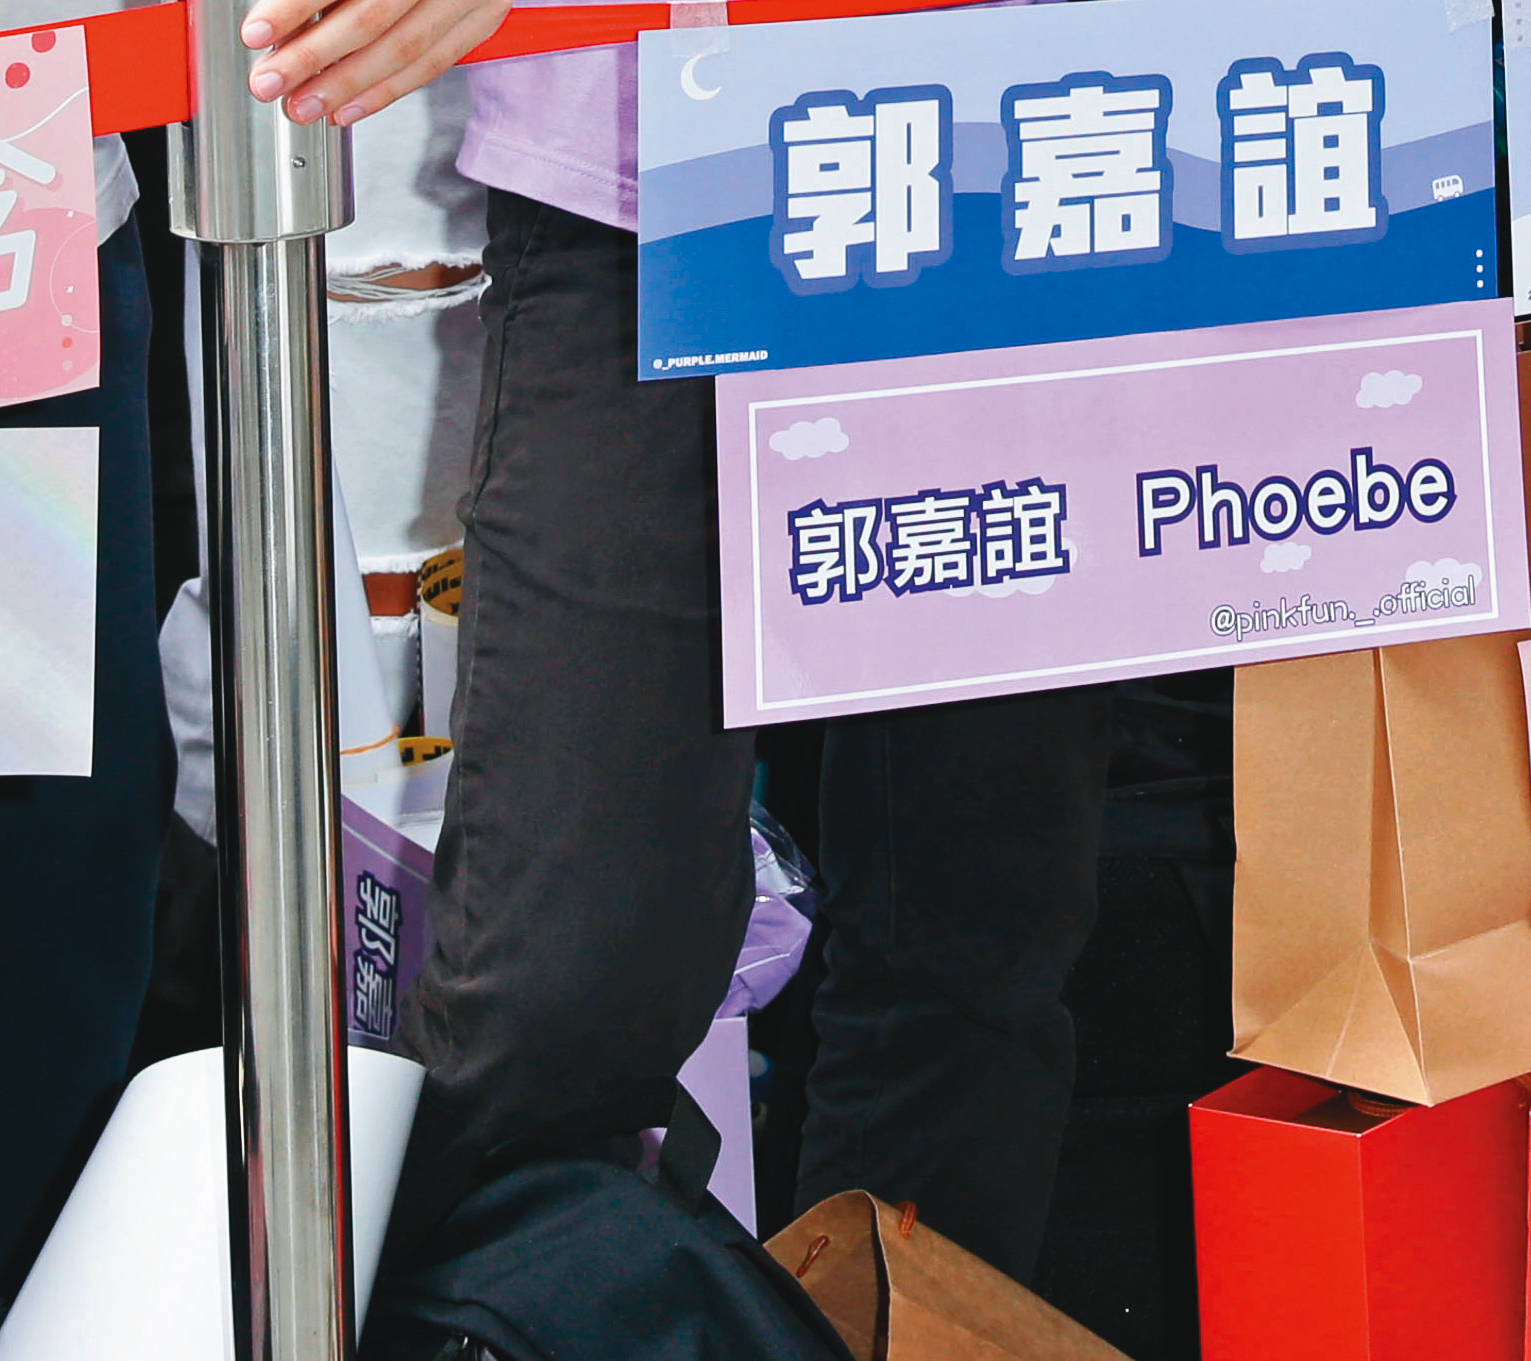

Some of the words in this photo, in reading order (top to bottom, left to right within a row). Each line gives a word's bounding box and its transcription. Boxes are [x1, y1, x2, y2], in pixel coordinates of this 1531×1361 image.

[777, 59, 1381, 285] 郭嘉誼
[651, 348, 769, 371] @_PURPLE.MERMAID
[790, 477, 1069, 605] 郭嘉誼
[1136, 444, 1459, 559] Phoebe
